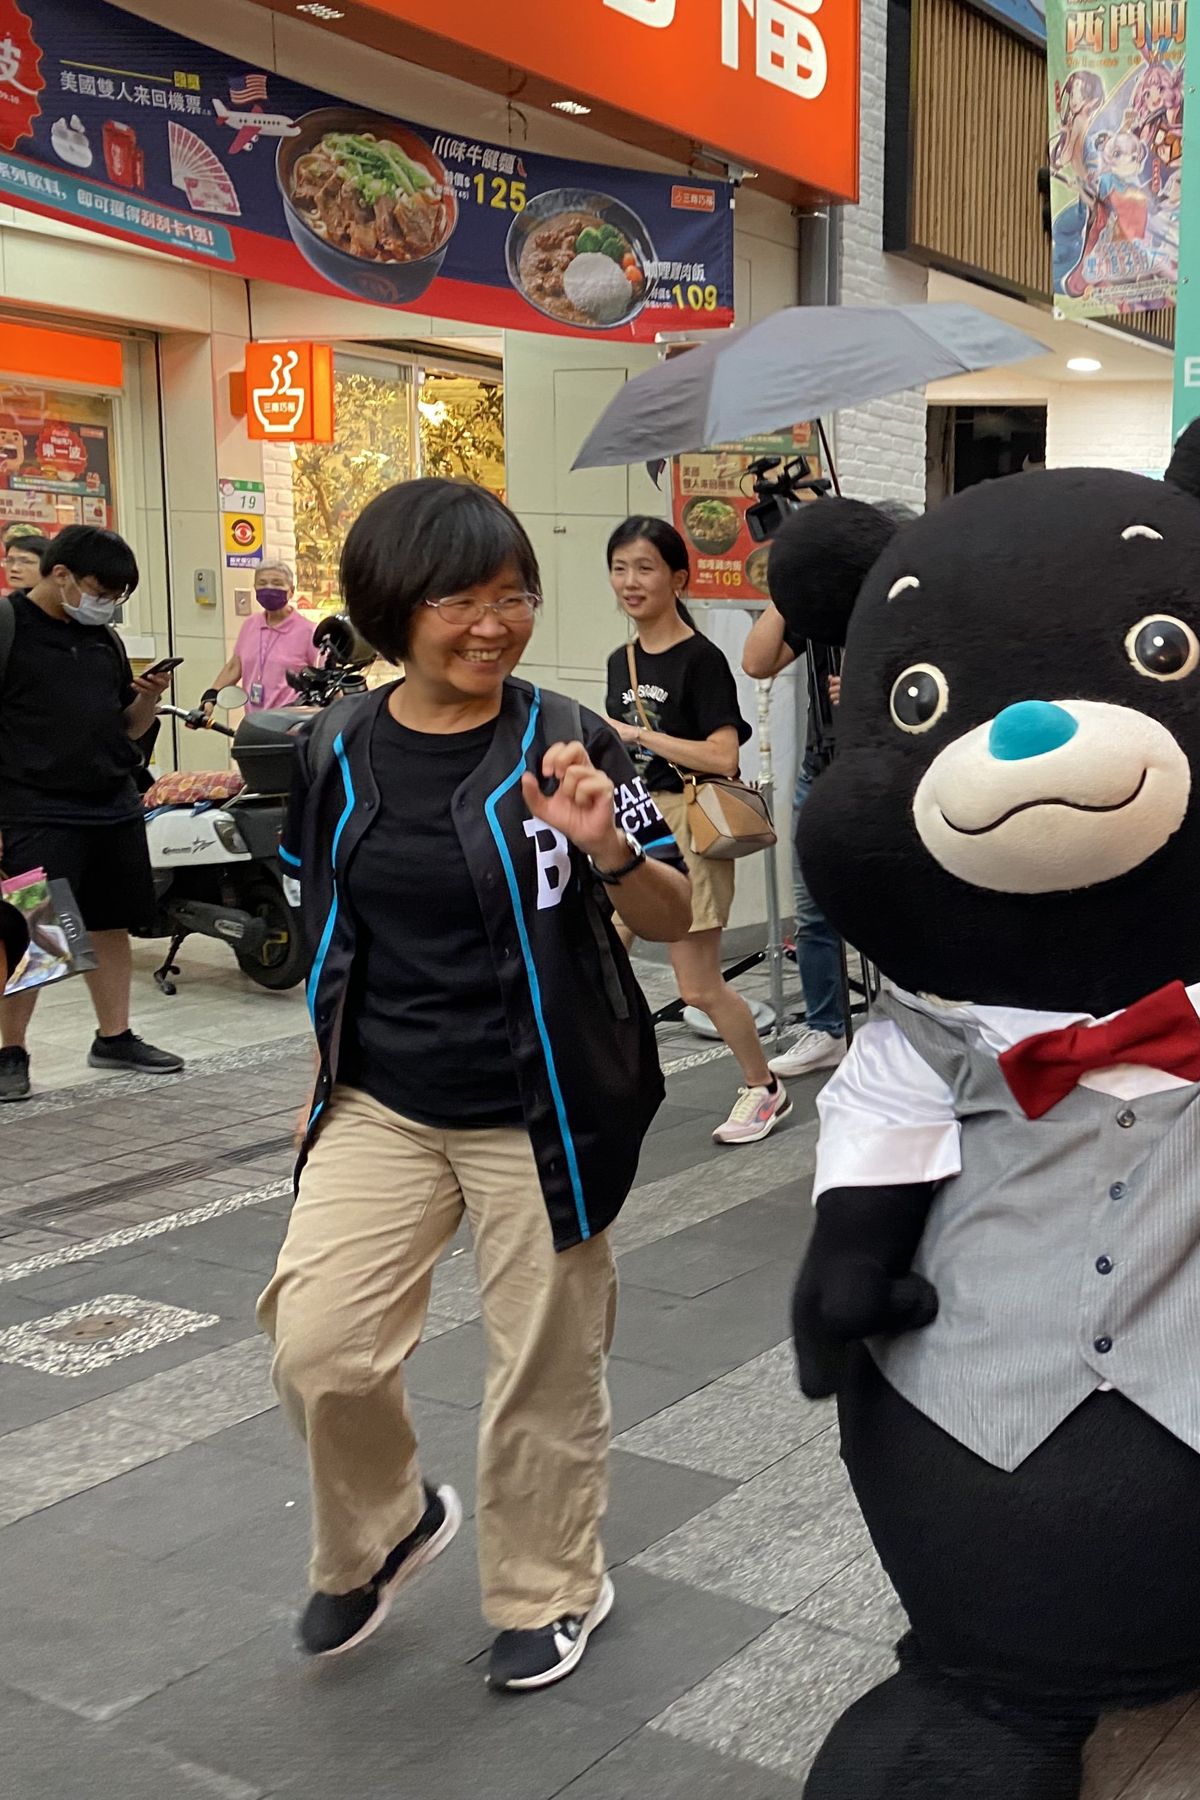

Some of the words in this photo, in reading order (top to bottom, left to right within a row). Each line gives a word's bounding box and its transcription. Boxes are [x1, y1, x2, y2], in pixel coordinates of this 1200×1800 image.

[472, 172, 527, 213] 125
[670, 283, 719, 312] 109
[240, 495, 257, 510] 19
[713, 571, 742, 587] 109
[522, 816, 572, 911] B
